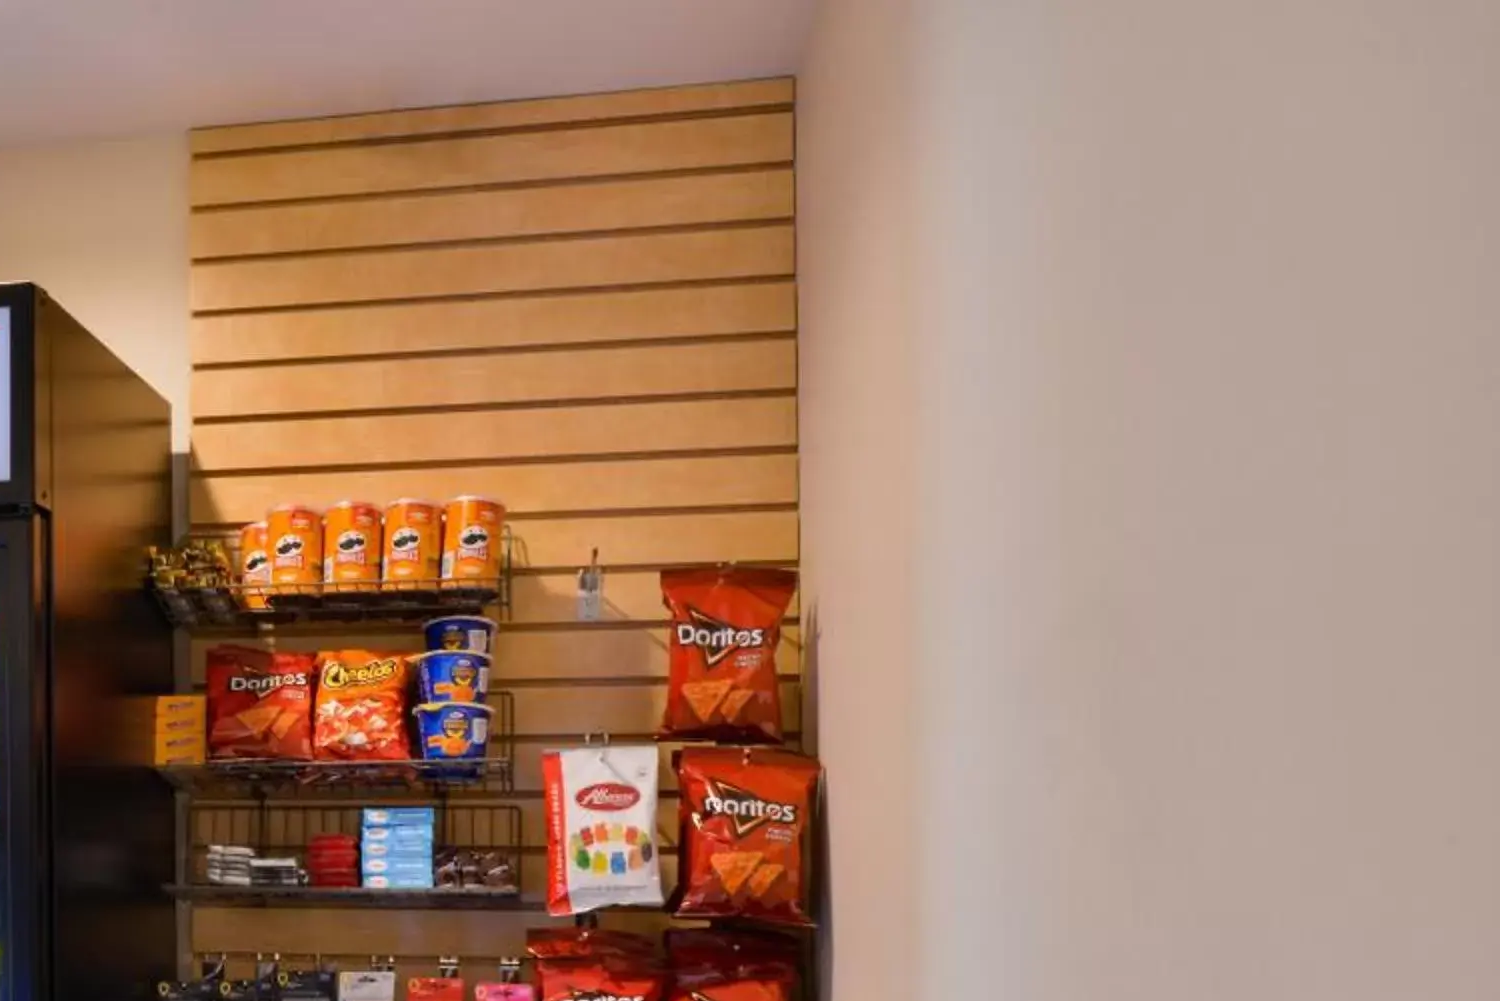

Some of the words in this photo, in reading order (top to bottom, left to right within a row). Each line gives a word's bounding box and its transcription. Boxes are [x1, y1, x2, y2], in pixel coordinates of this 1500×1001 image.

[678, 624, 764, 646] Doritos
[231, 671, 307, 692] Doritos
[324, 660, 397, 688] Cheetos
[705, 796, 796, 822] Doritos
